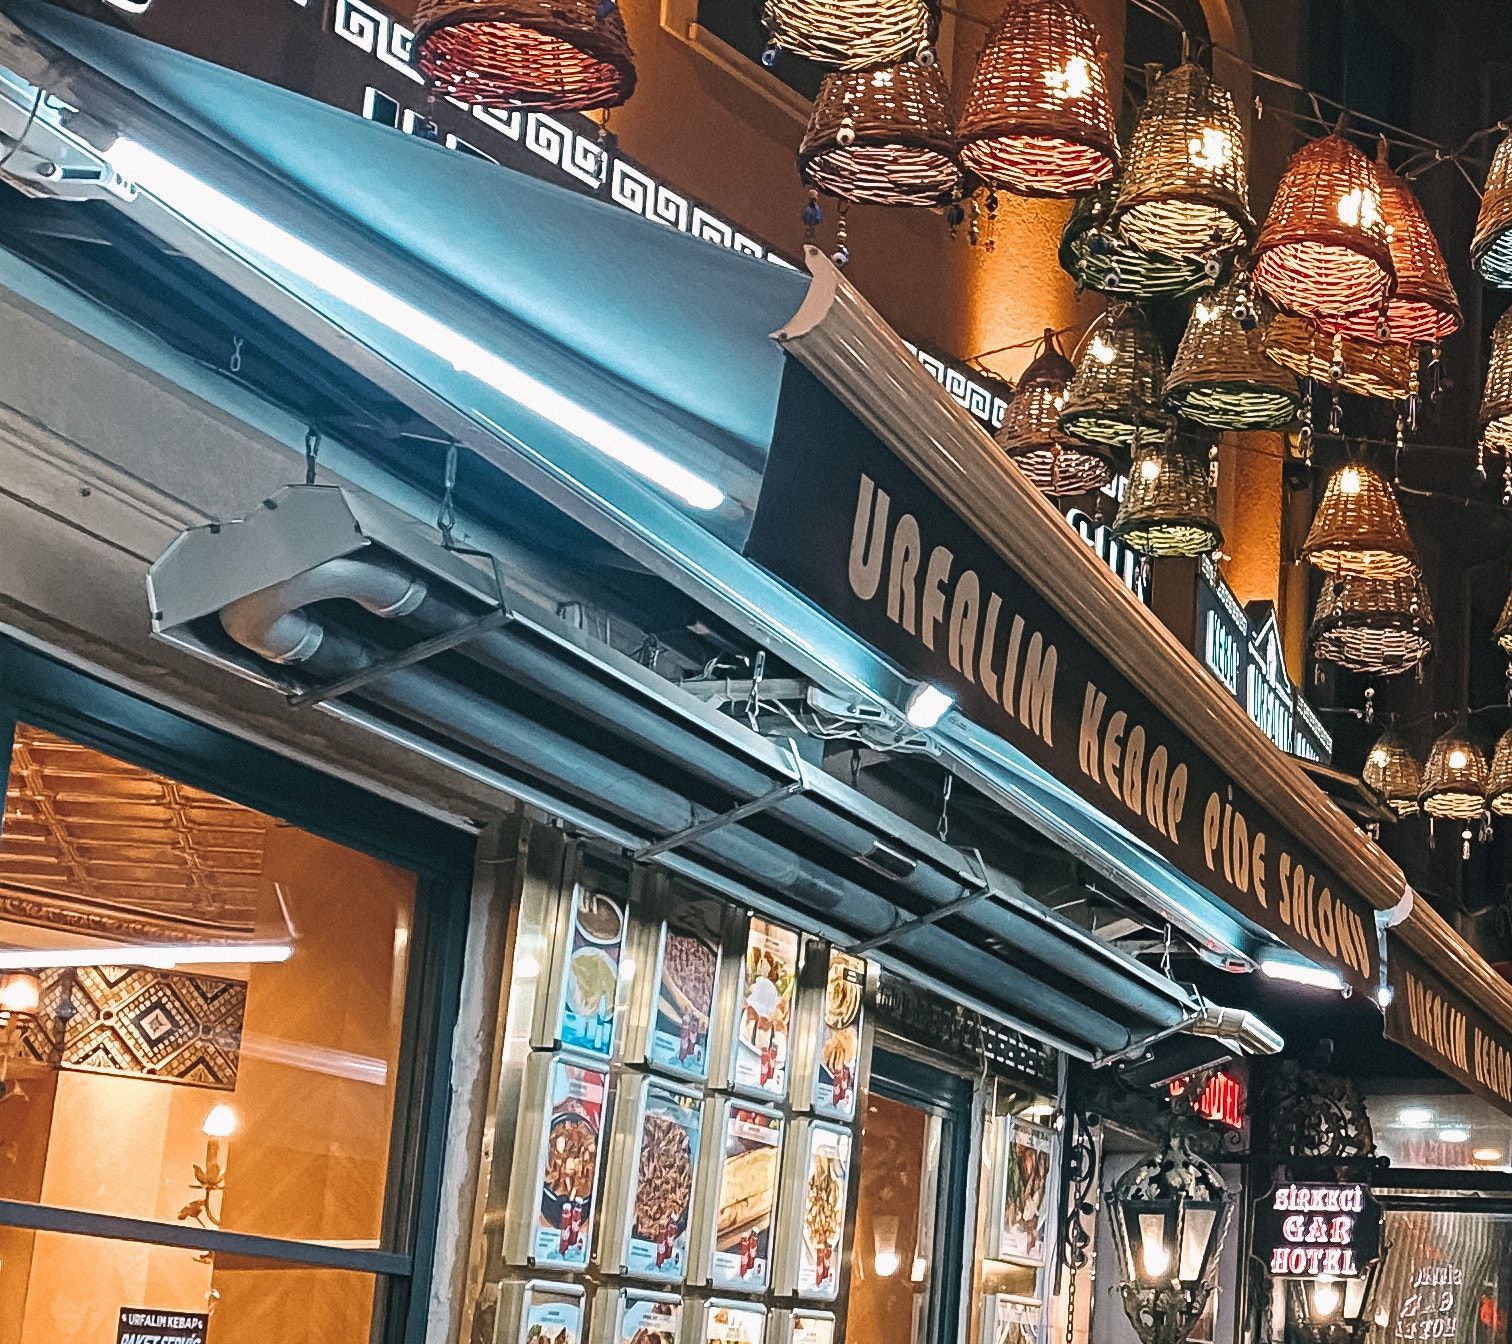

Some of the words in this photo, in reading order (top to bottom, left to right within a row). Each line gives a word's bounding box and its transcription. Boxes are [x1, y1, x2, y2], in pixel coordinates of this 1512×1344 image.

[848, 473, 1058, 747] URFALIM
[1078, 681, 1188, 845] KEBAP
[1203, 784, 1267, 909] PİDE
[1279, 852, 1370, 979] SALONU
[1406, 971, 1469, 1073] URFALIM
[1474, 1026, 1512, 1102] KEBAP
[1282, 1215, 1353, 1244] GAR
[1271, 1248, 1357, 1275] HOTEL
[128, 1313, 167, 1327] URFALIM
[167, 1315, 198, 1329] KEBAP
